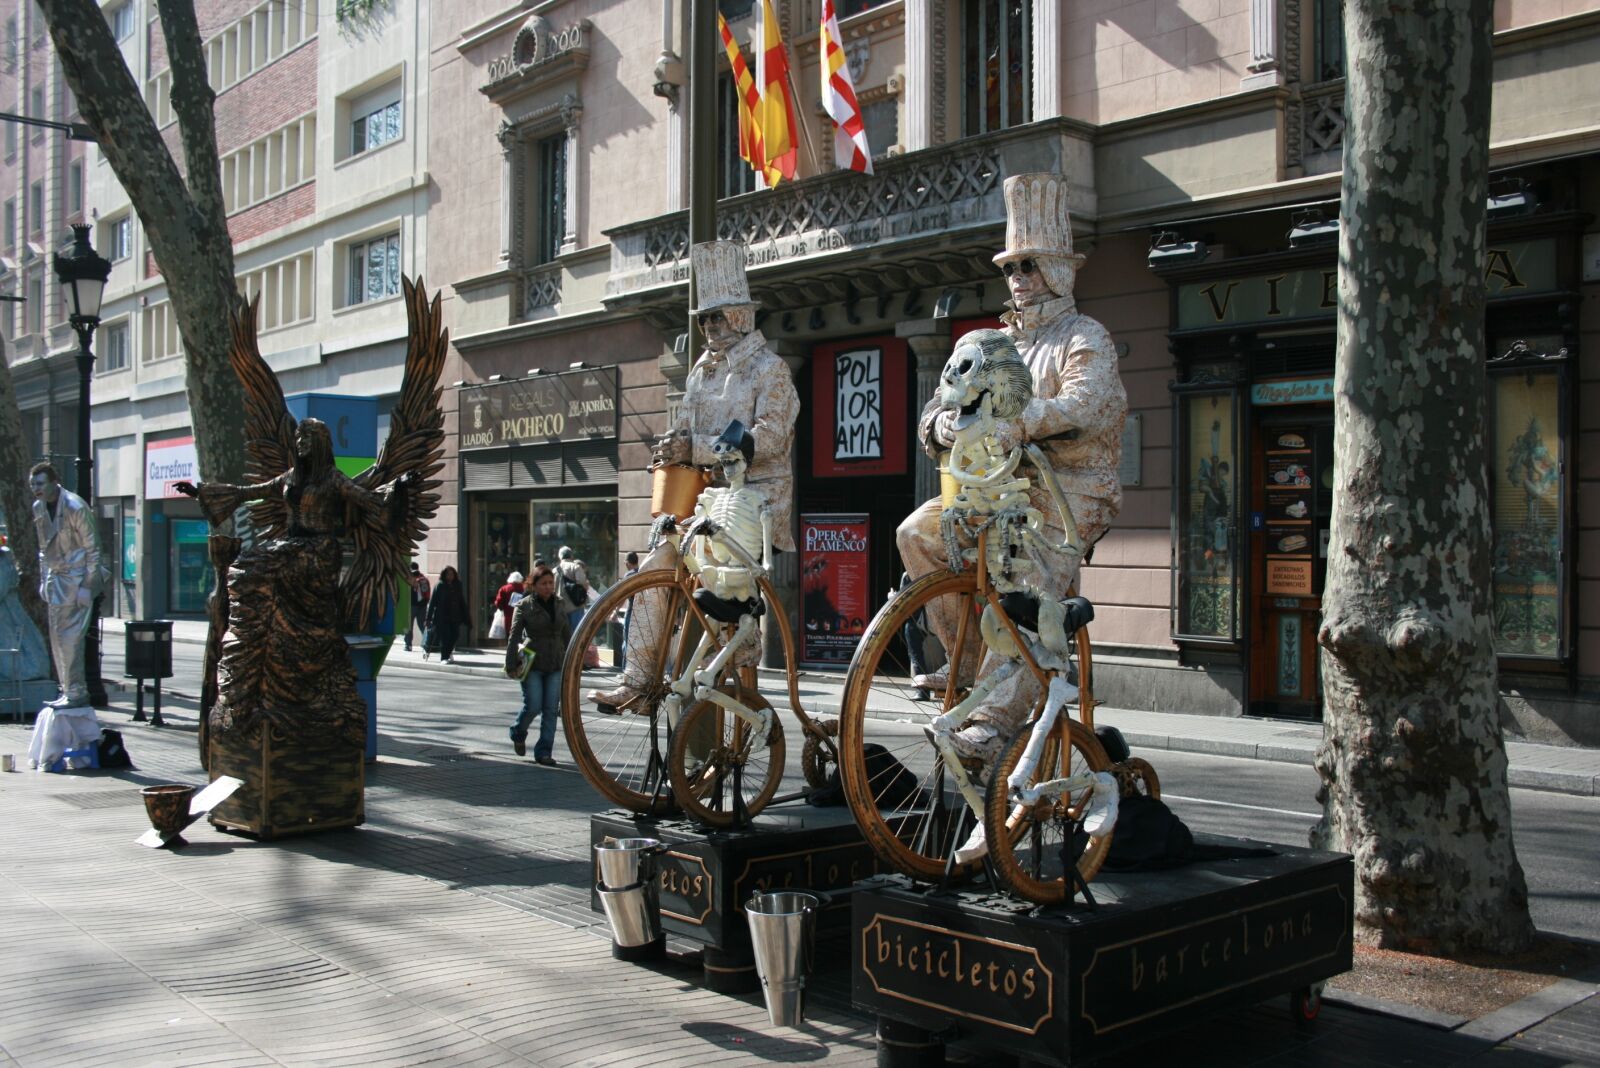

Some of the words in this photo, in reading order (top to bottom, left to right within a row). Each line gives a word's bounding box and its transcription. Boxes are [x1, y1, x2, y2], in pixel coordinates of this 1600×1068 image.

[791, 242, 807, 257] DE
[909, 212, 948, 234] ARTS
[1200, 249, 1527, 321] VIEA
[838, 355, 880, 389] POL
[509, 389, 554, 411] REGALS
[840, 390, 880, 422] IOR
[501, 413, 564, 440] PACHECO
[837, 421, 880, 454] AMA
[149, 460, 192, 480] Carrefour
[806, 527, 845, 541] OPERA
[806, 539, 865, 551] FLAMENCO
[876, 922, 1036, 999] bicicletos
[1132, 911, 1313, 991] barcelona
